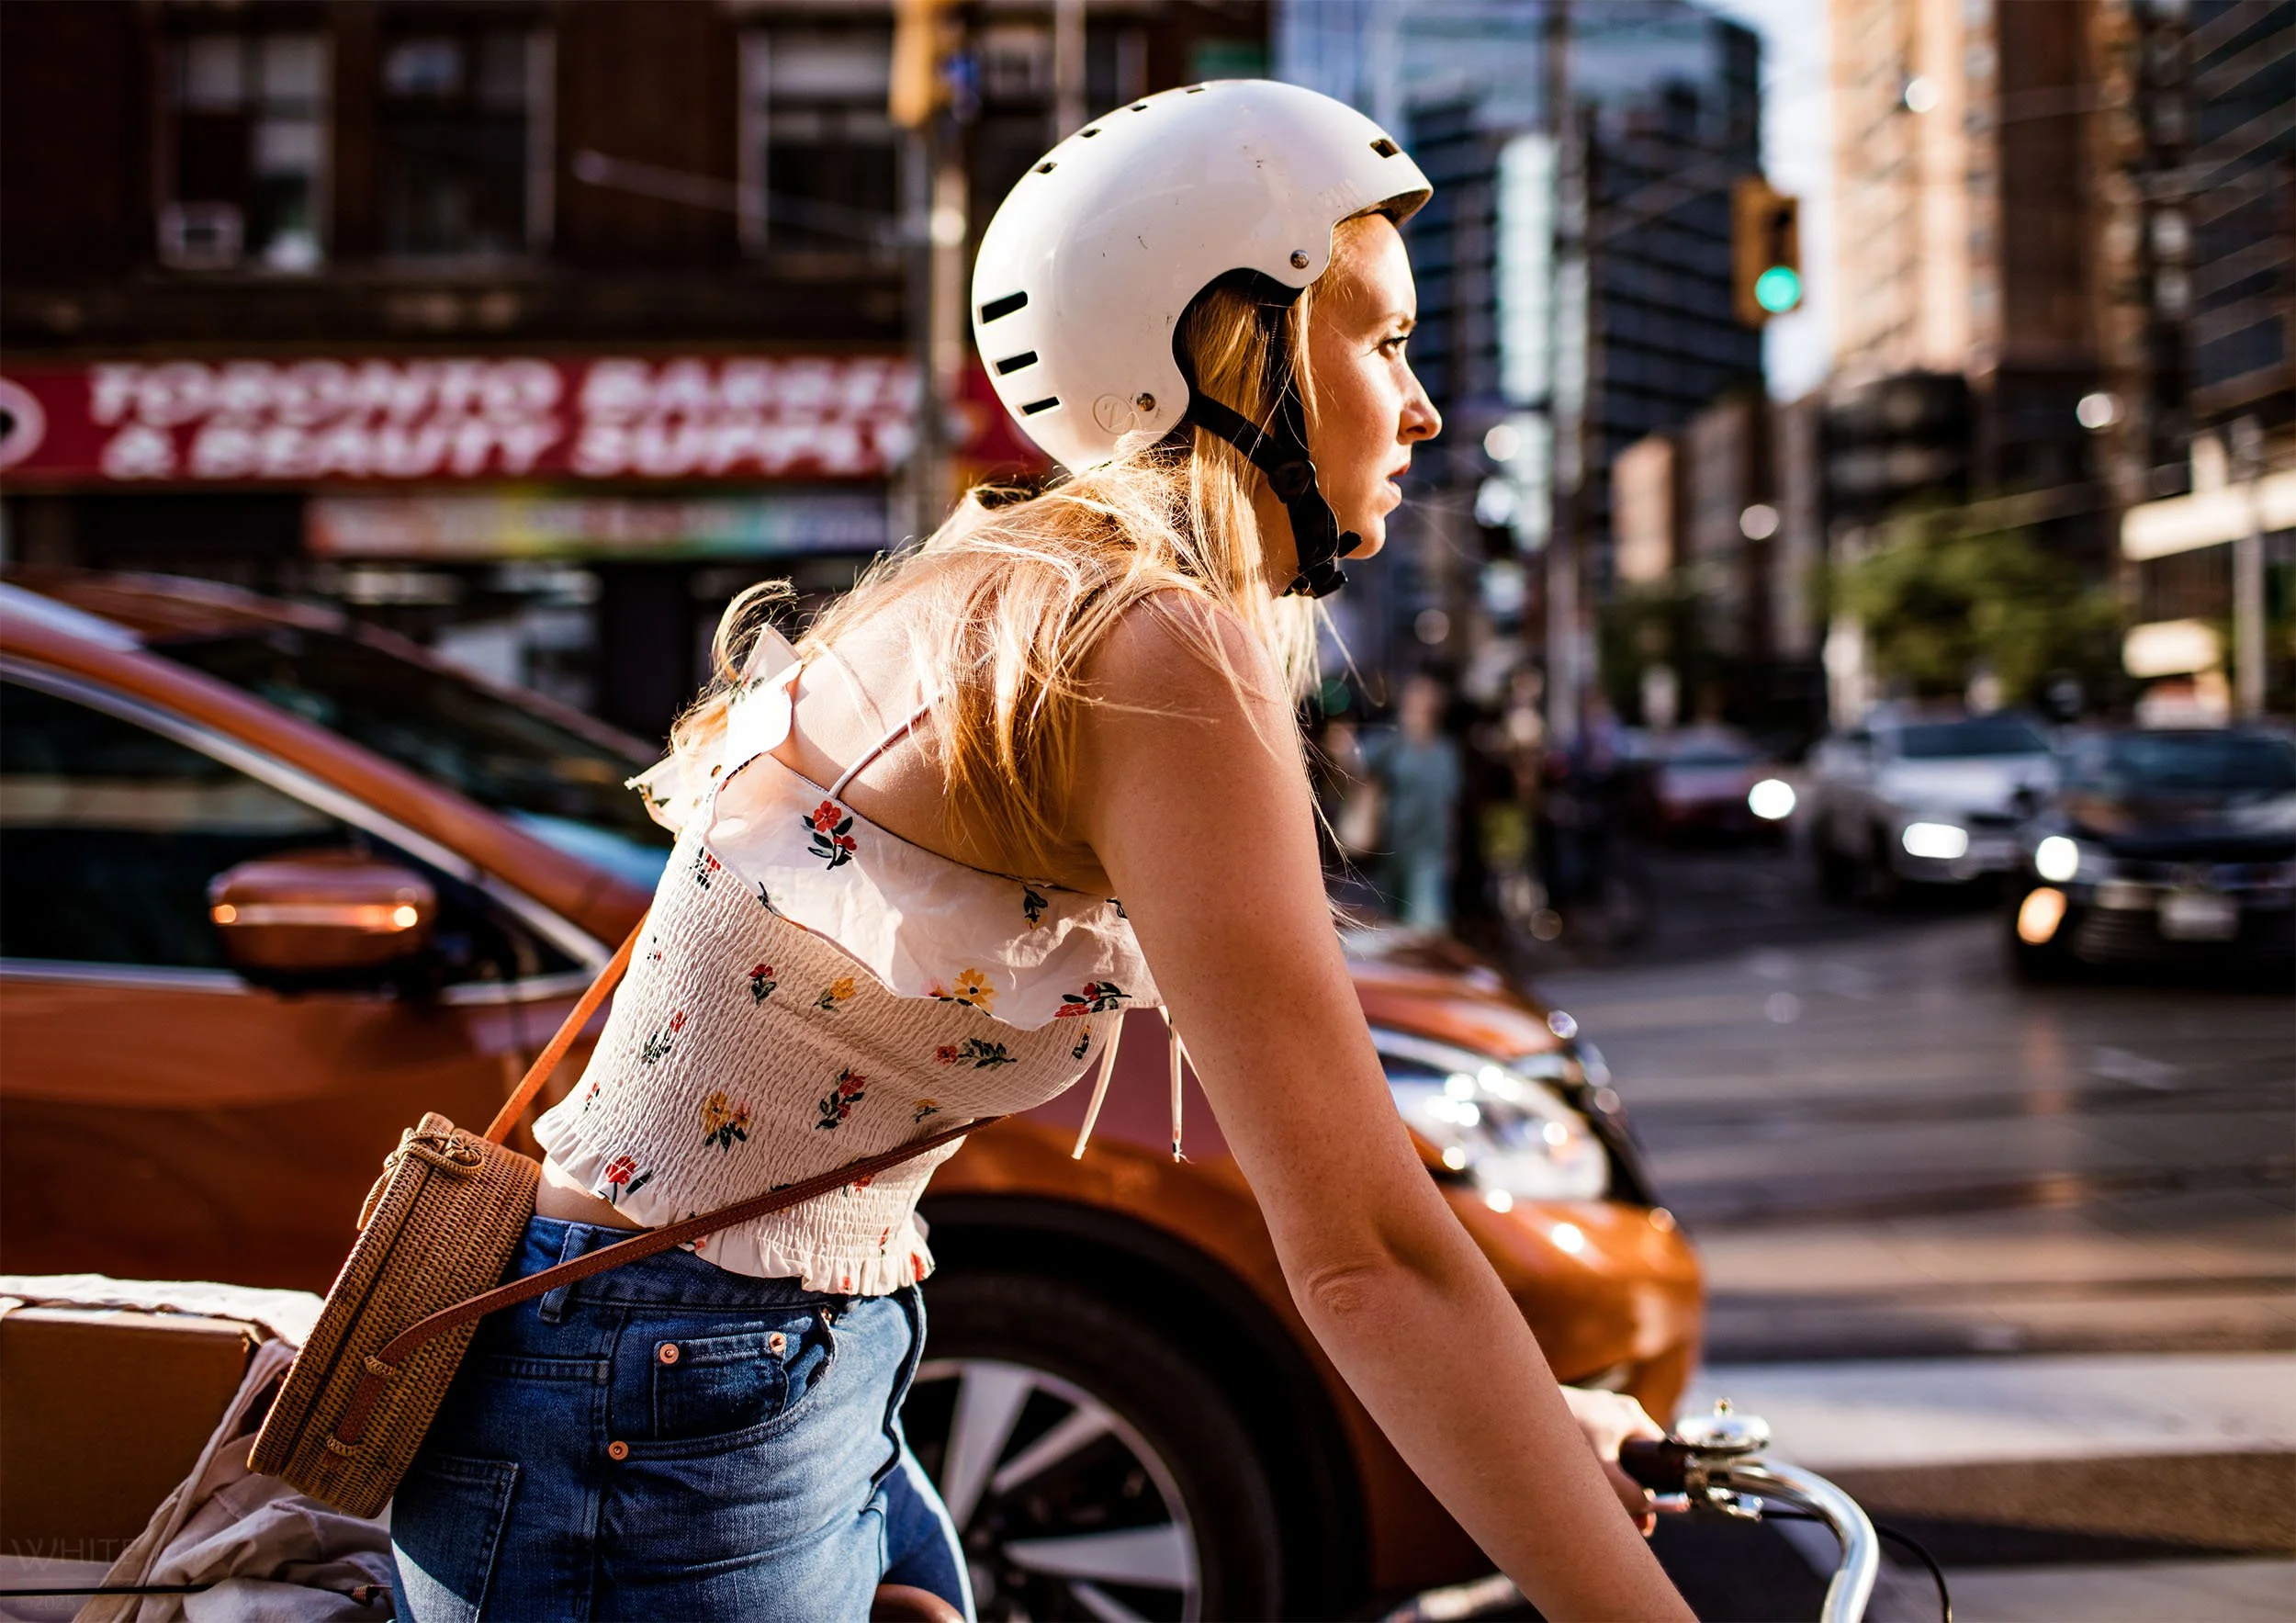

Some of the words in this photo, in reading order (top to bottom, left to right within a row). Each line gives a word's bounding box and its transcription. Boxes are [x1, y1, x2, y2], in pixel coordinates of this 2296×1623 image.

[90, 359, 562, 426] TORONTO
[102, 419, 177, 479] &
[190, 418, 560, 479] BEAUTY
